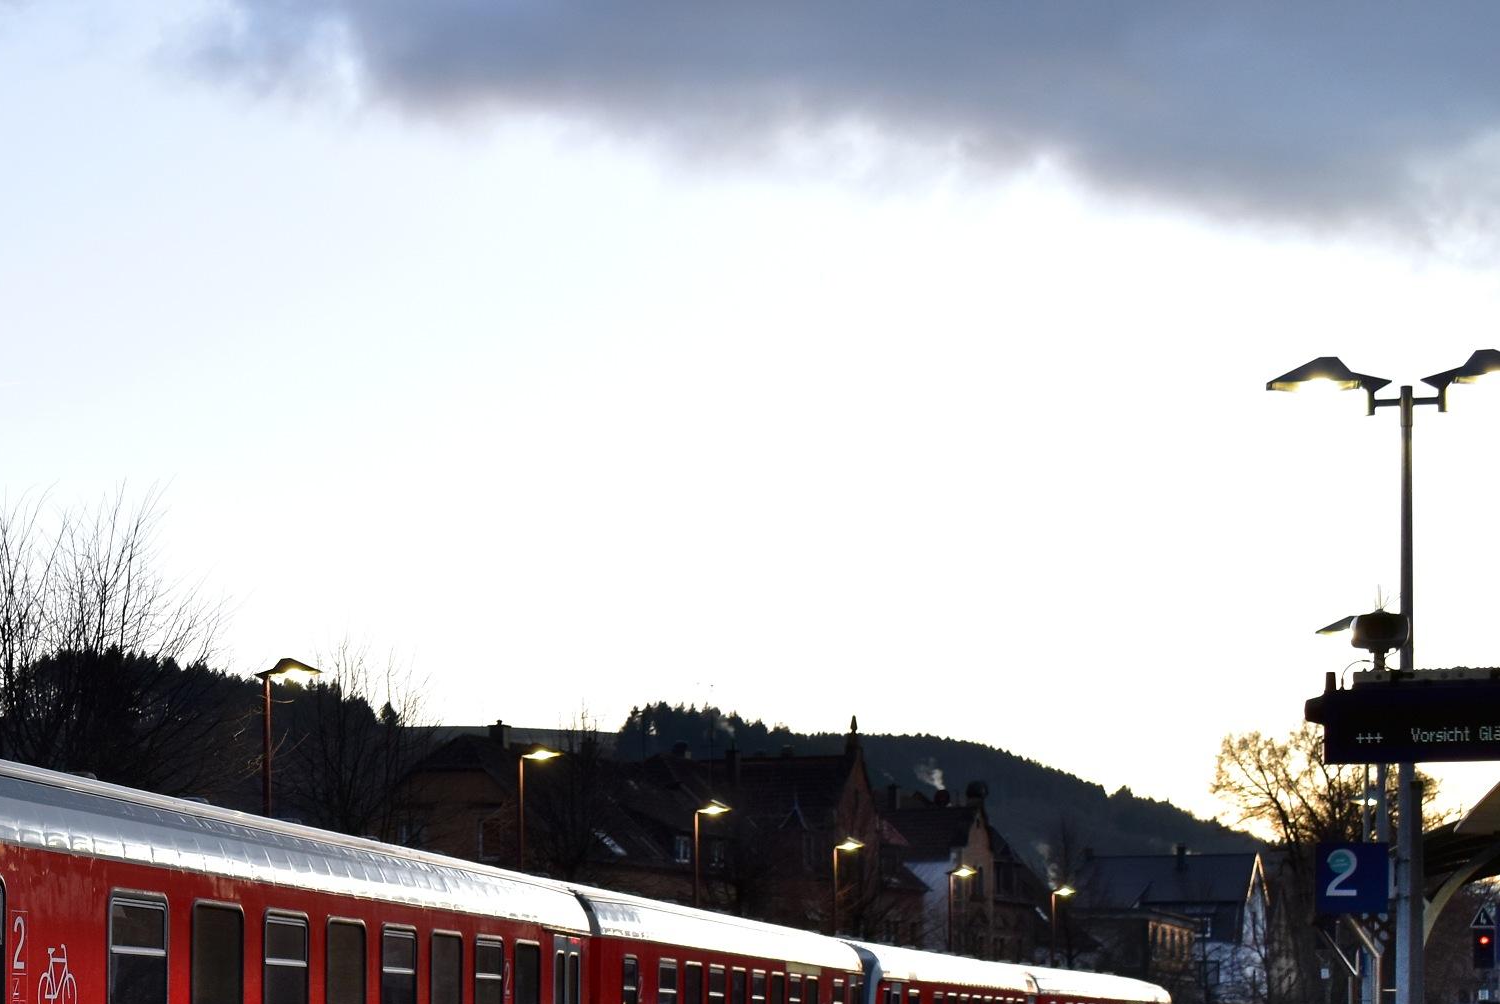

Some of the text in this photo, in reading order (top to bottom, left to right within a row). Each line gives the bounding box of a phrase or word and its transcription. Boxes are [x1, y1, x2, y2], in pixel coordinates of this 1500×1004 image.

[1411, 726, 1470, 742] Vorsicht
[1326, 848, 1358, 897] 2
[12, 915, 26, 970] 2
